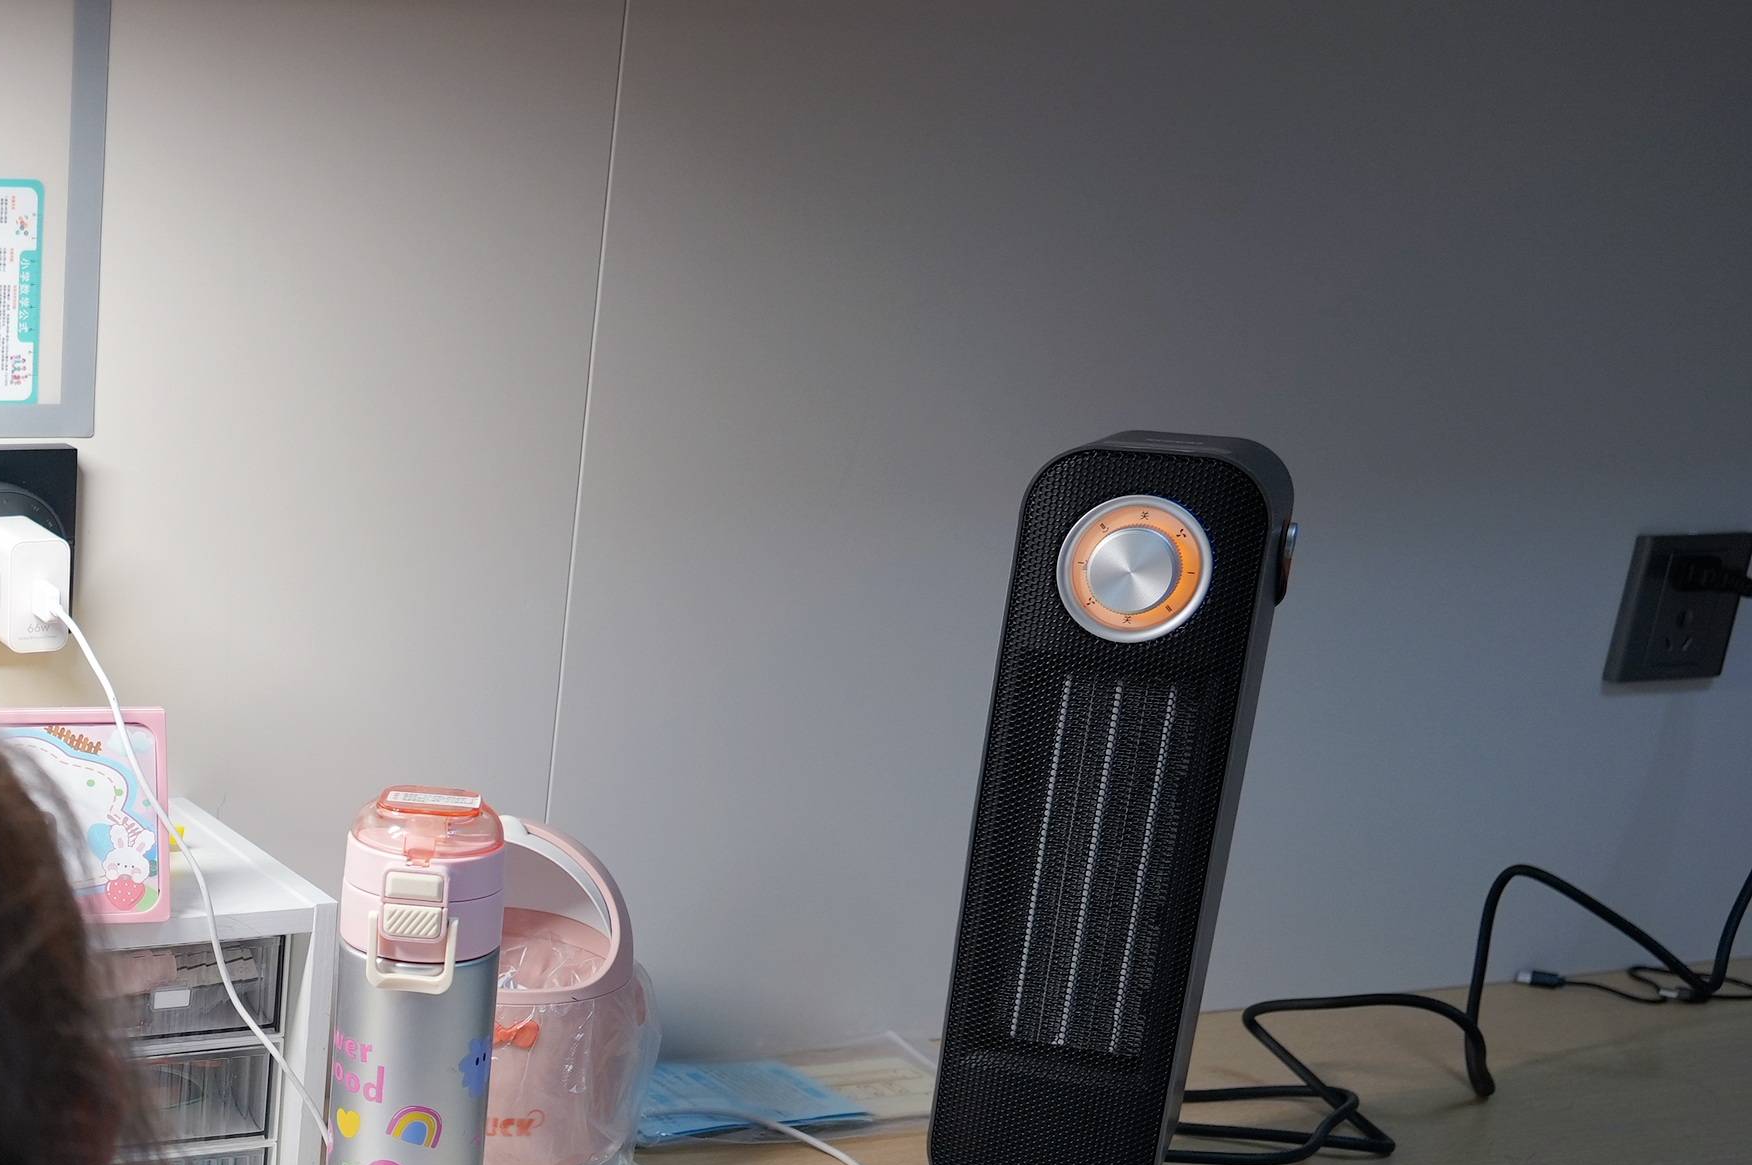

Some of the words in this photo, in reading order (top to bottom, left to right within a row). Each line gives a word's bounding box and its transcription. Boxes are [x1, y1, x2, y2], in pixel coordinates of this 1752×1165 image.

[19, 257, 31, 333] 小学数学公式
[27, 624, 50, 634] 66W
